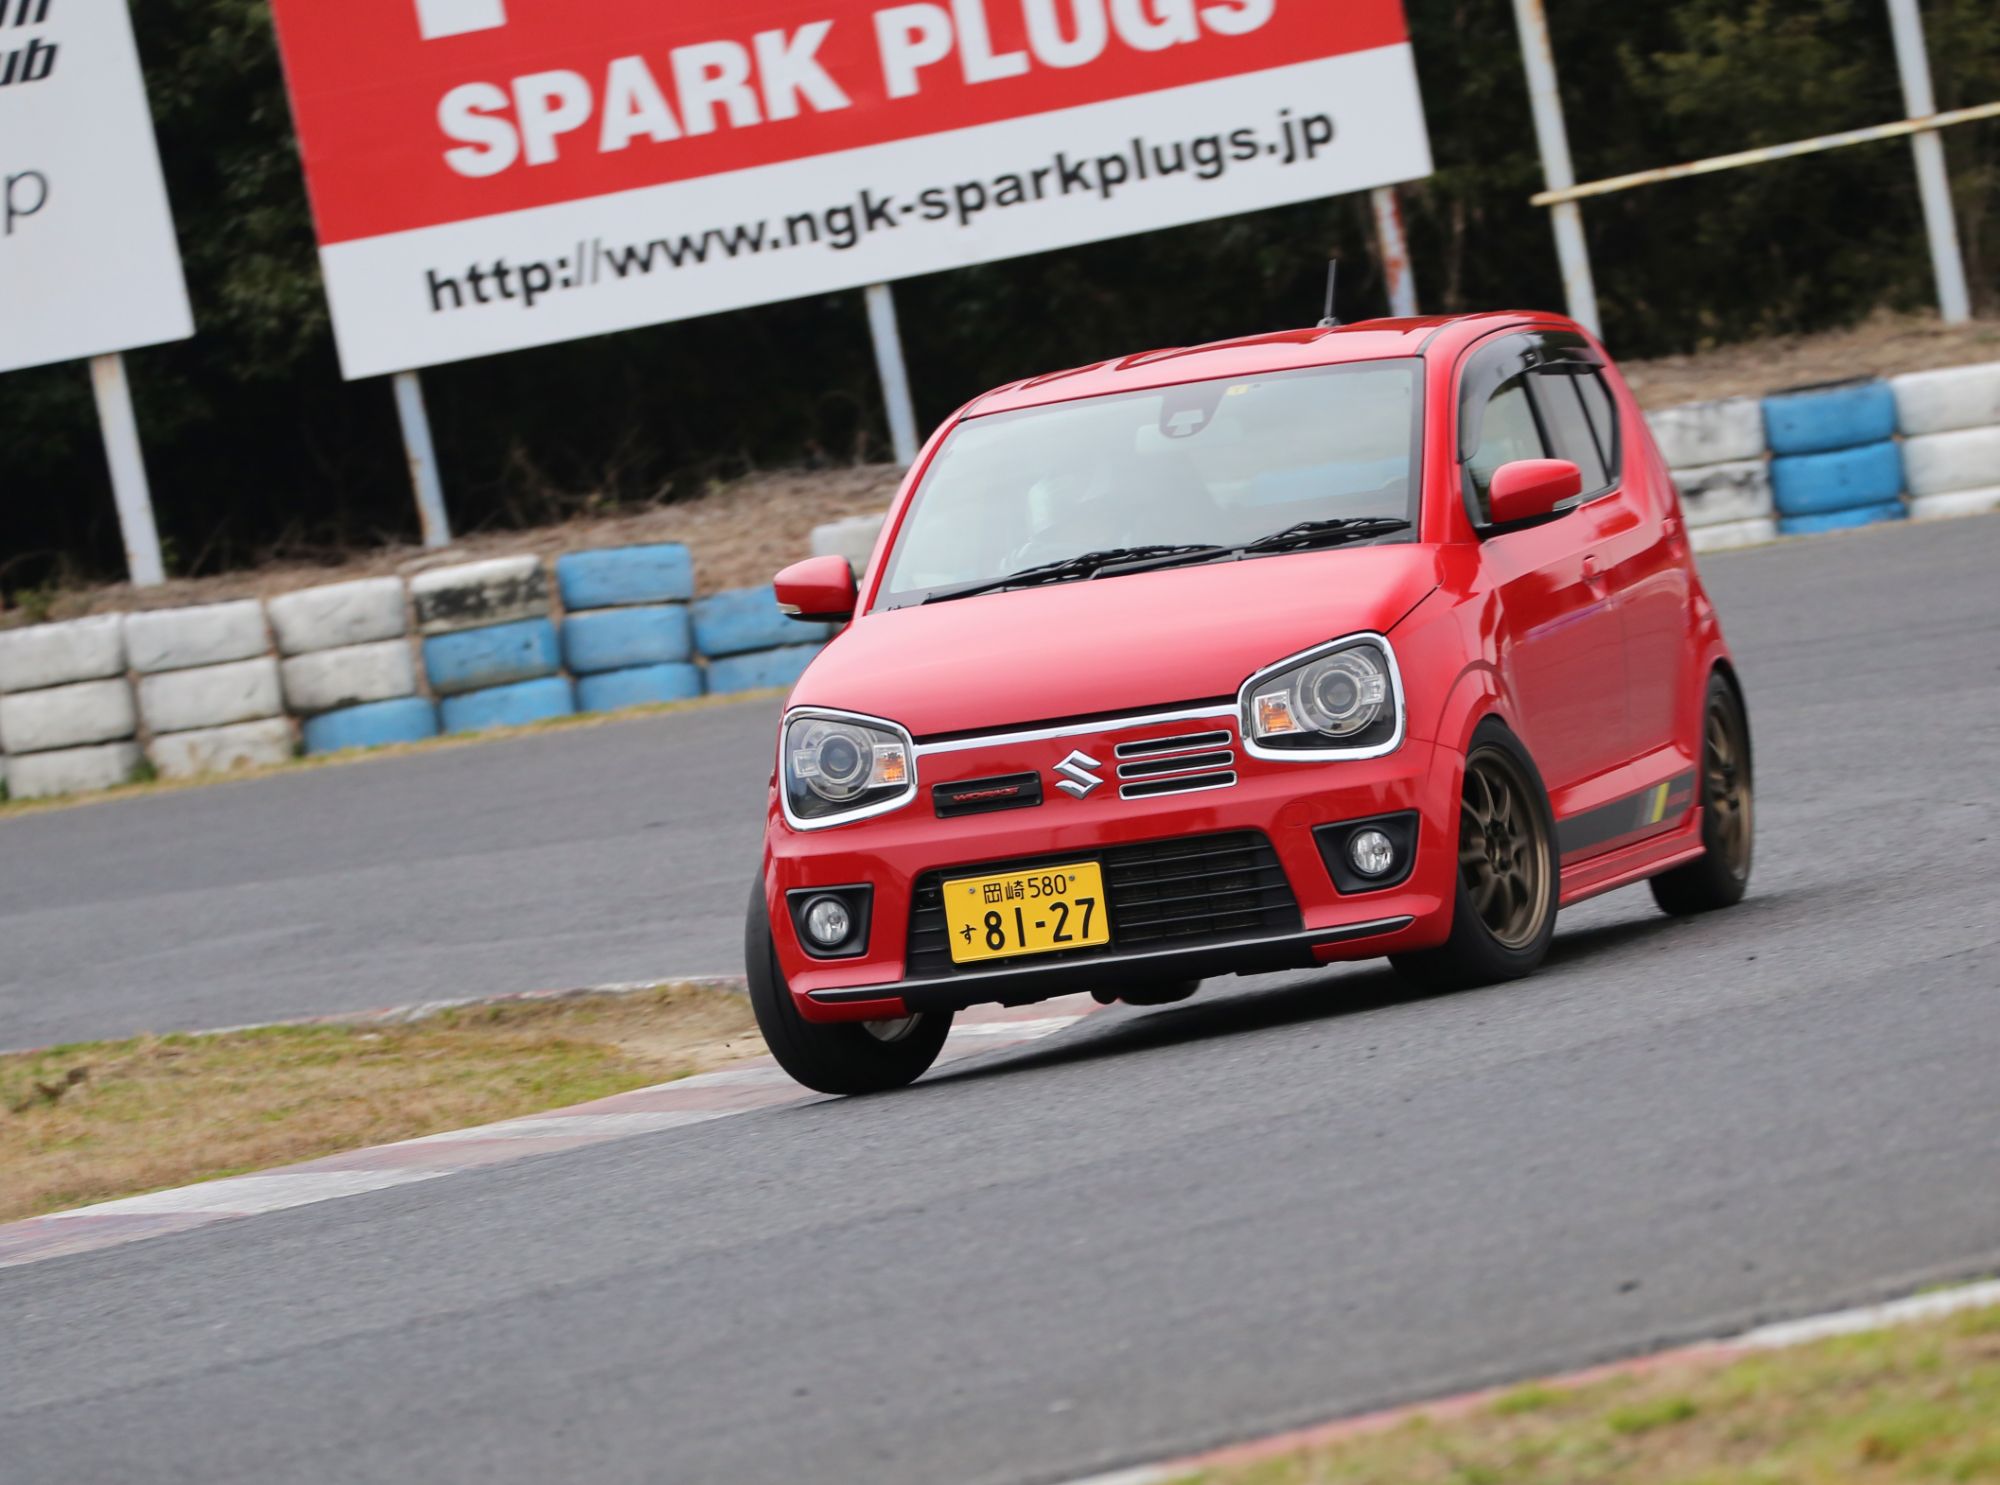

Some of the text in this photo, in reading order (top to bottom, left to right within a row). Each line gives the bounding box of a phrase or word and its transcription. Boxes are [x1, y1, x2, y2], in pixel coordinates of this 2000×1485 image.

[436, 19, 852, 179] SPARK
[426, 109, 1335, 311] http://www.ngk-sparkplugs.jp
[983, 897, 1096, 950] 81-27
